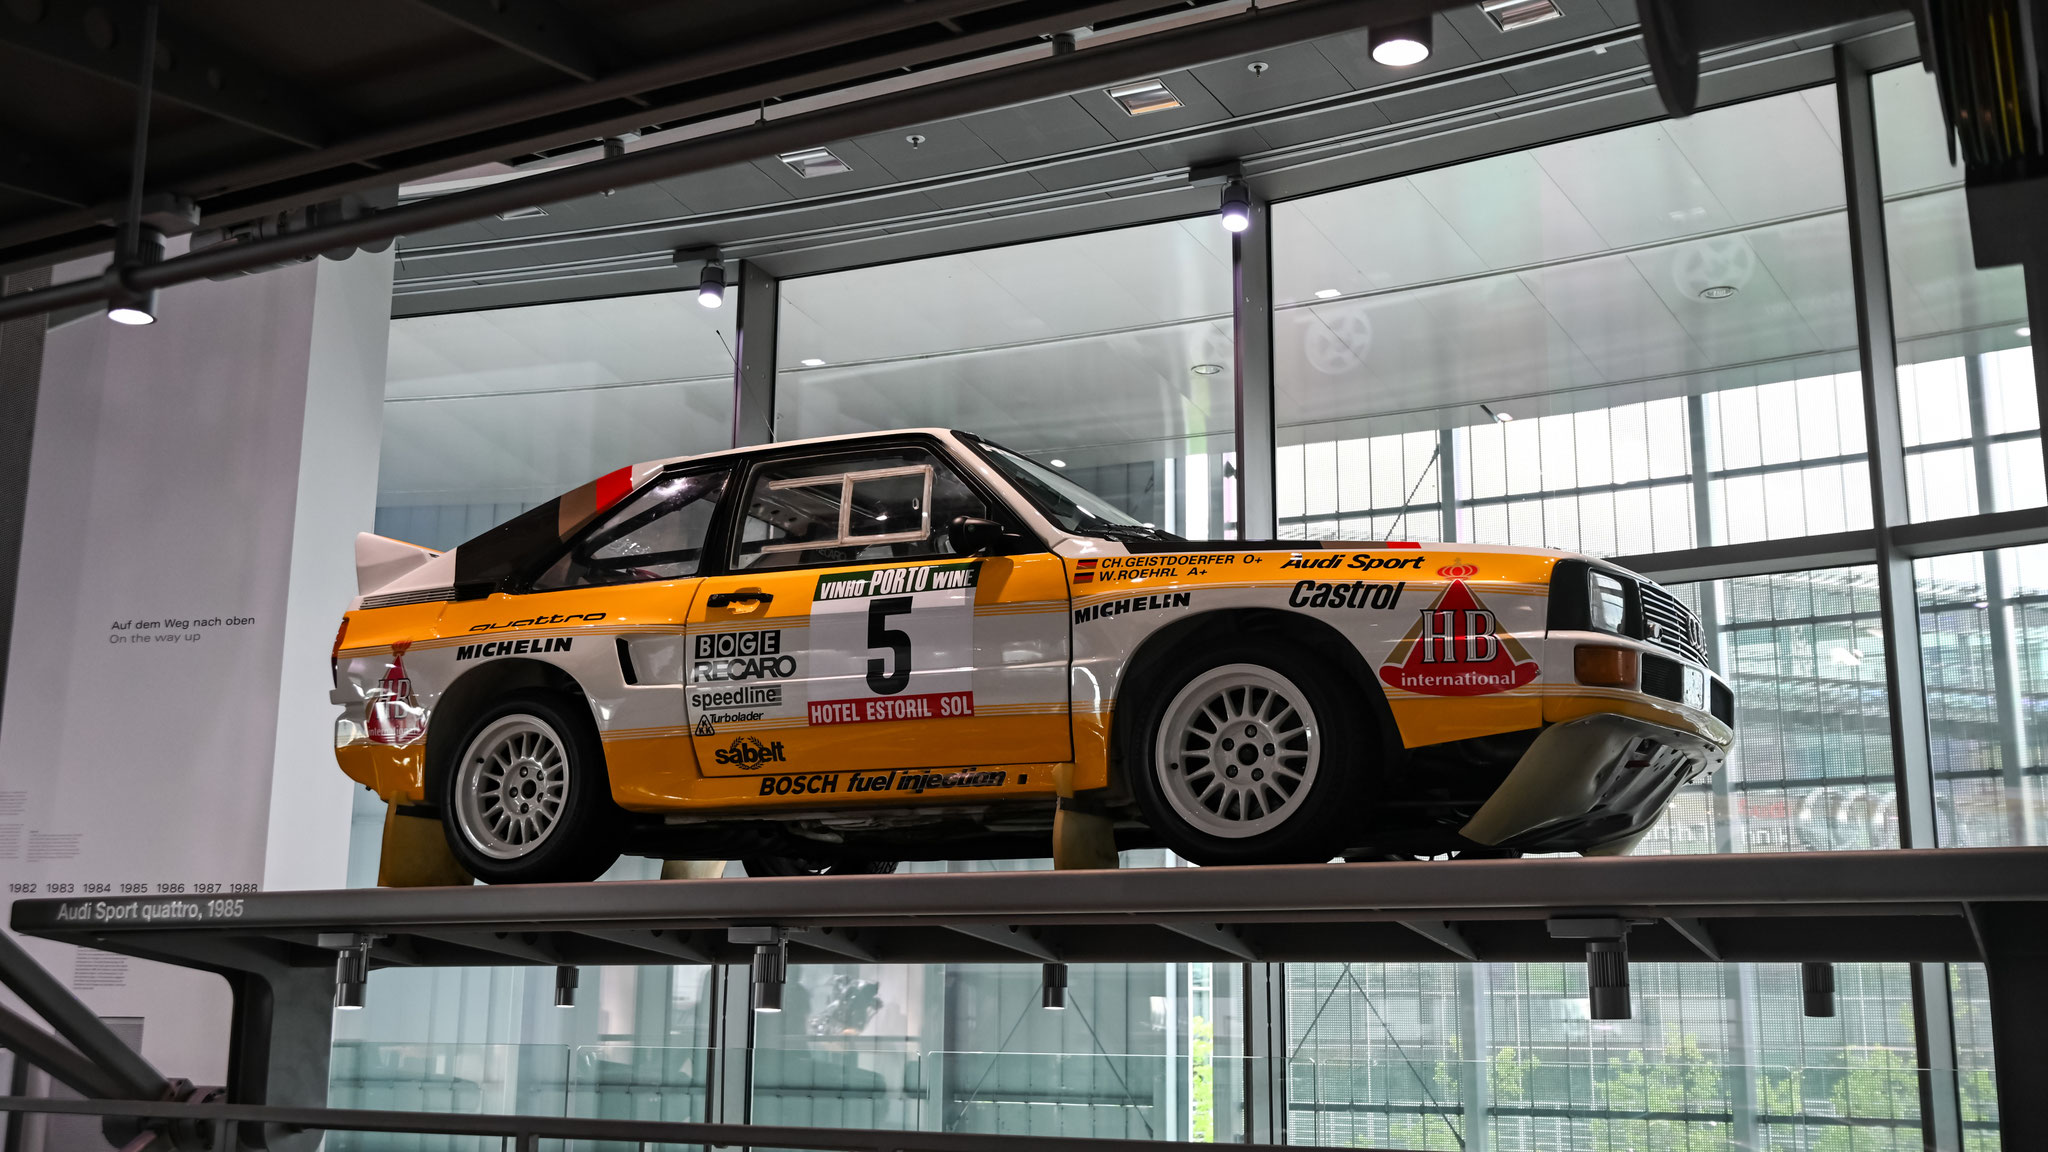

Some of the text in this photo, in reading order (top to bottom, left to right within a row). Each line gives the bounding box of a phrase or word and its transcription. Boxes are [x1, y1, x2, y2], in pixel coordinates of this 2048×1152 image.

[1101, 554, 1235, 569] CH.GEISTDOERFER
[1281, 554, 1425, 571] Audi Sport
[820, 566, 975, 600] VINHO PORTO WINE
[1099, 567, 1208, 582] W.ROEHRL A+
[1289, 580, 1406, 610] Castrol
[1075, 592, 1191, 625] MICHELIN
[111, 616, 256, 630] Auf dem Weg nach oben
[469, 612, 606, 632] quattro
[109, 633, 202, 644] On the way up
[456, 637, 573, 661] MICHELIN
[698, 631, 777, 658] BOGE
[866, 596, 913, 696] 5
[694, 655, 797, 683] RECARO
[1401, 669, 1516, 687] international
[692, 686, 777, 710] speedline
[811, 696, 972, 724] HOTEL ESTORIL SOL
[709, 711, 764, 724] Turbolader
[715, 741, 786, 765] sabelt
[759, 768, 1007, 796] BOSCH fuel injection
[9, 883, 258, 894] 1982 1983 1984 1985 1986 1987 1988
[57, 899, 245, 922] Audi Sport quattro, 1985
